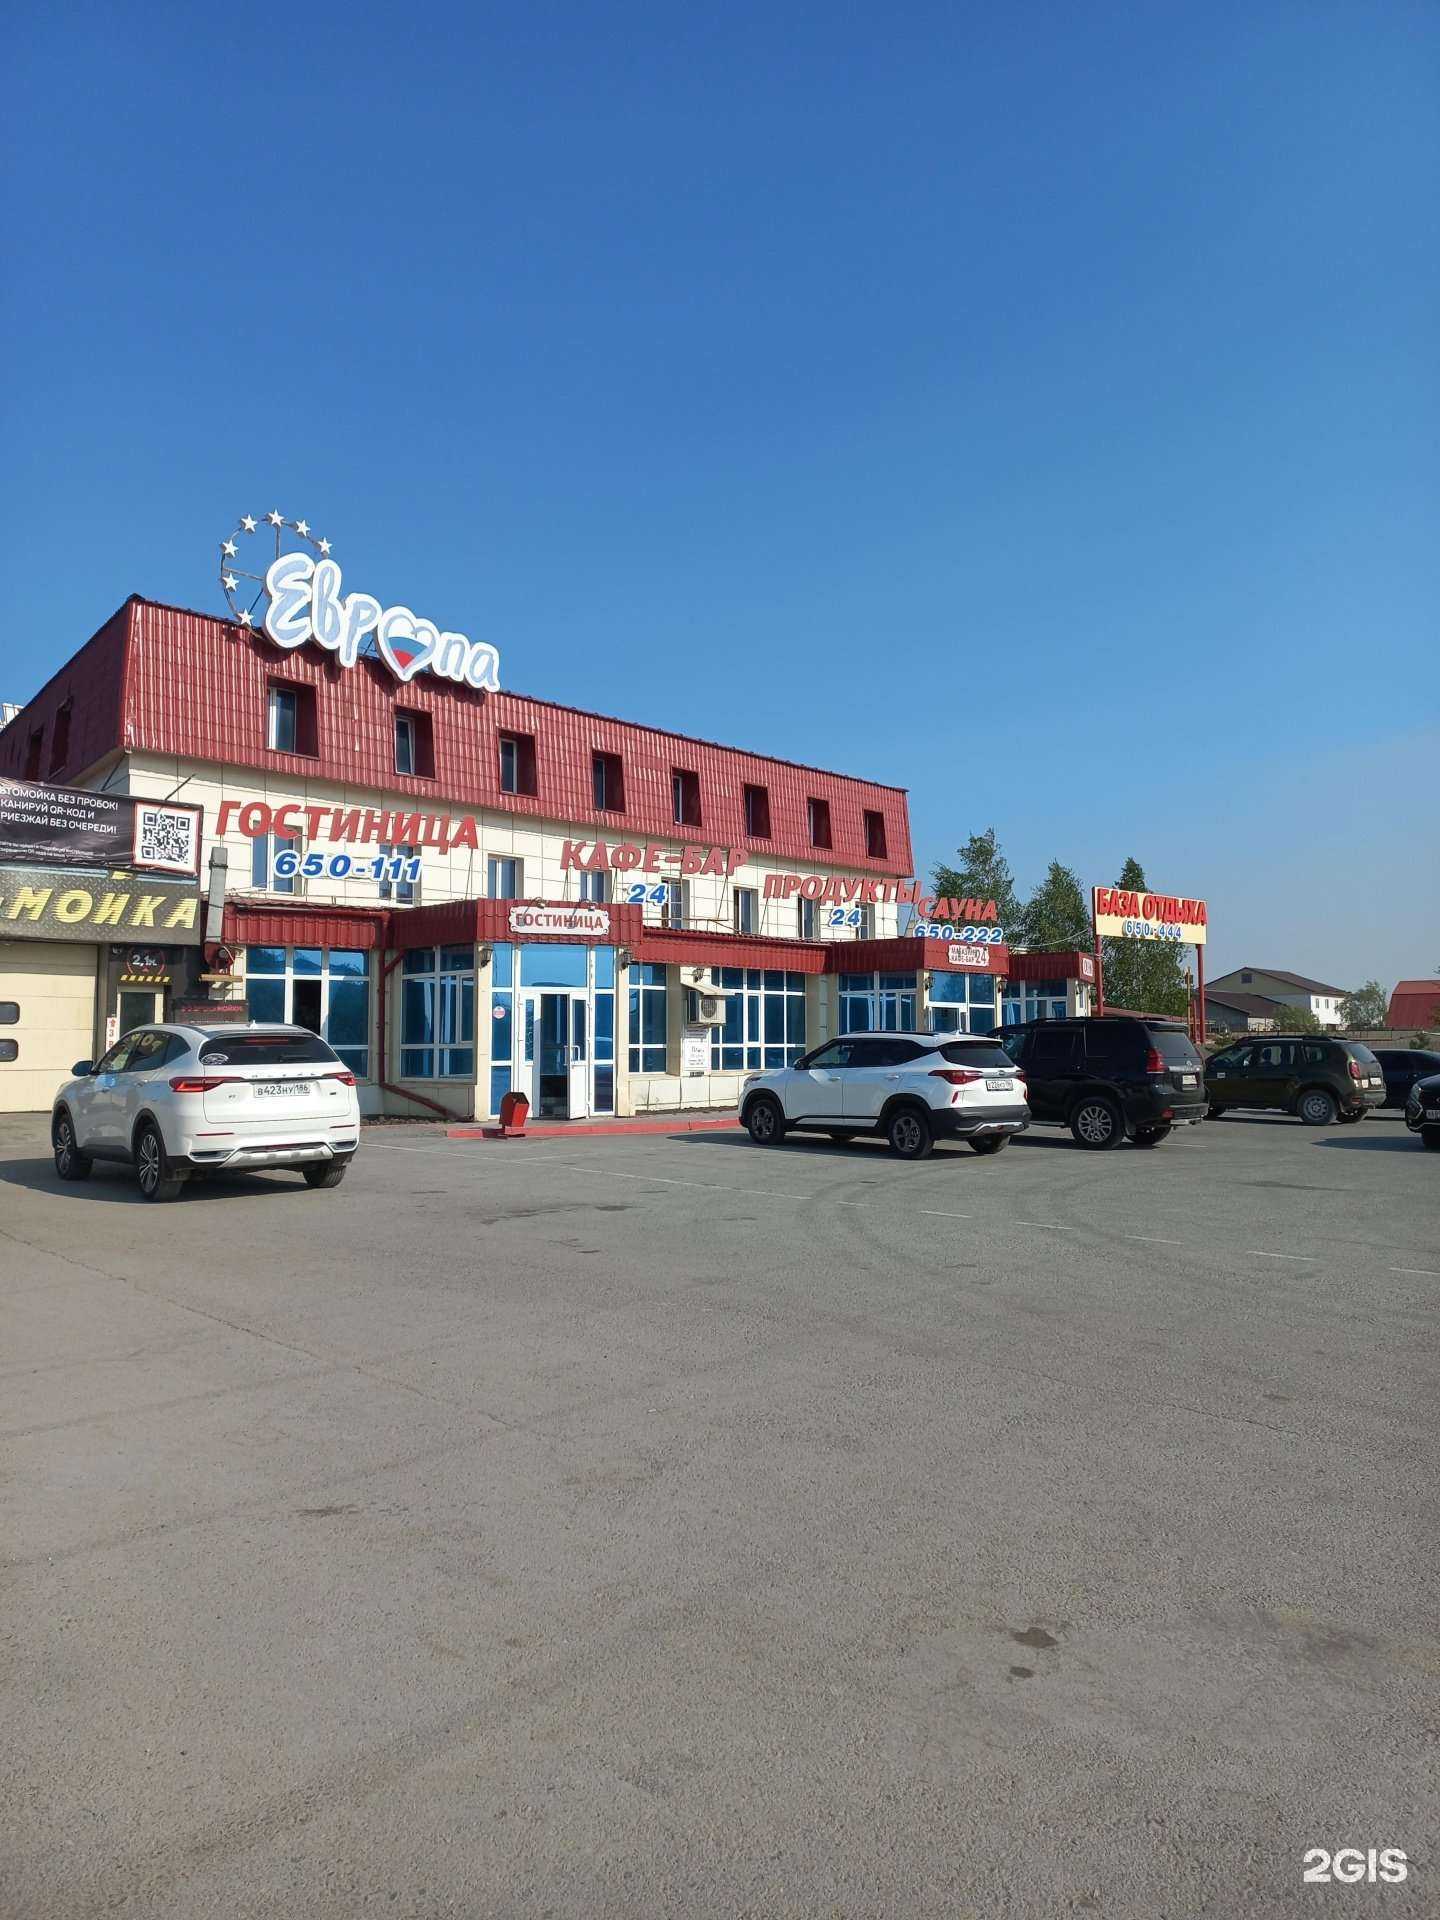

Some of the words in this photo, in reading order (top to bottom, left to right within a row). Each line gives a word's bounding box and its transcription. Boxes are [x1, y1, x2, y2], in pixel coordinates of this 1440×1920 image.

[50, 805, 86, 819] QR-КОД
[87, 811, 95, 820] И
[58, 794, 75, 805] БЕЗ
[77, 797, 119, 811] ПРОБОК!
[50, 818, 67, 828] БЕЗ
[69, 821, 117, 835] ОЧЕРЕДИ!
[215, 800, 479, 855] ГОСТИНИЦА
[273, 851, 422, 882] 650-111
[560, 840, 749, 876] КАФЕ-БАР
[0, 872, 198, 928] МОЙКА
[627, 883, 667, 905] 24
[762, 874, 922, 906] ПРОДУКТЫ
[830, 908, 862, 927] 24
[917, 897, 999, 922] САУНА
[1097, 888, 1140, 918] БАЗА
[1142, 895, 1207, 926] ОТДЫХА
[515, 913, 604, 931] ГОСТИНИЦА
[1125, 920, 1182, 938] 650-444
[913, 924, 1003, 944] 650-222
